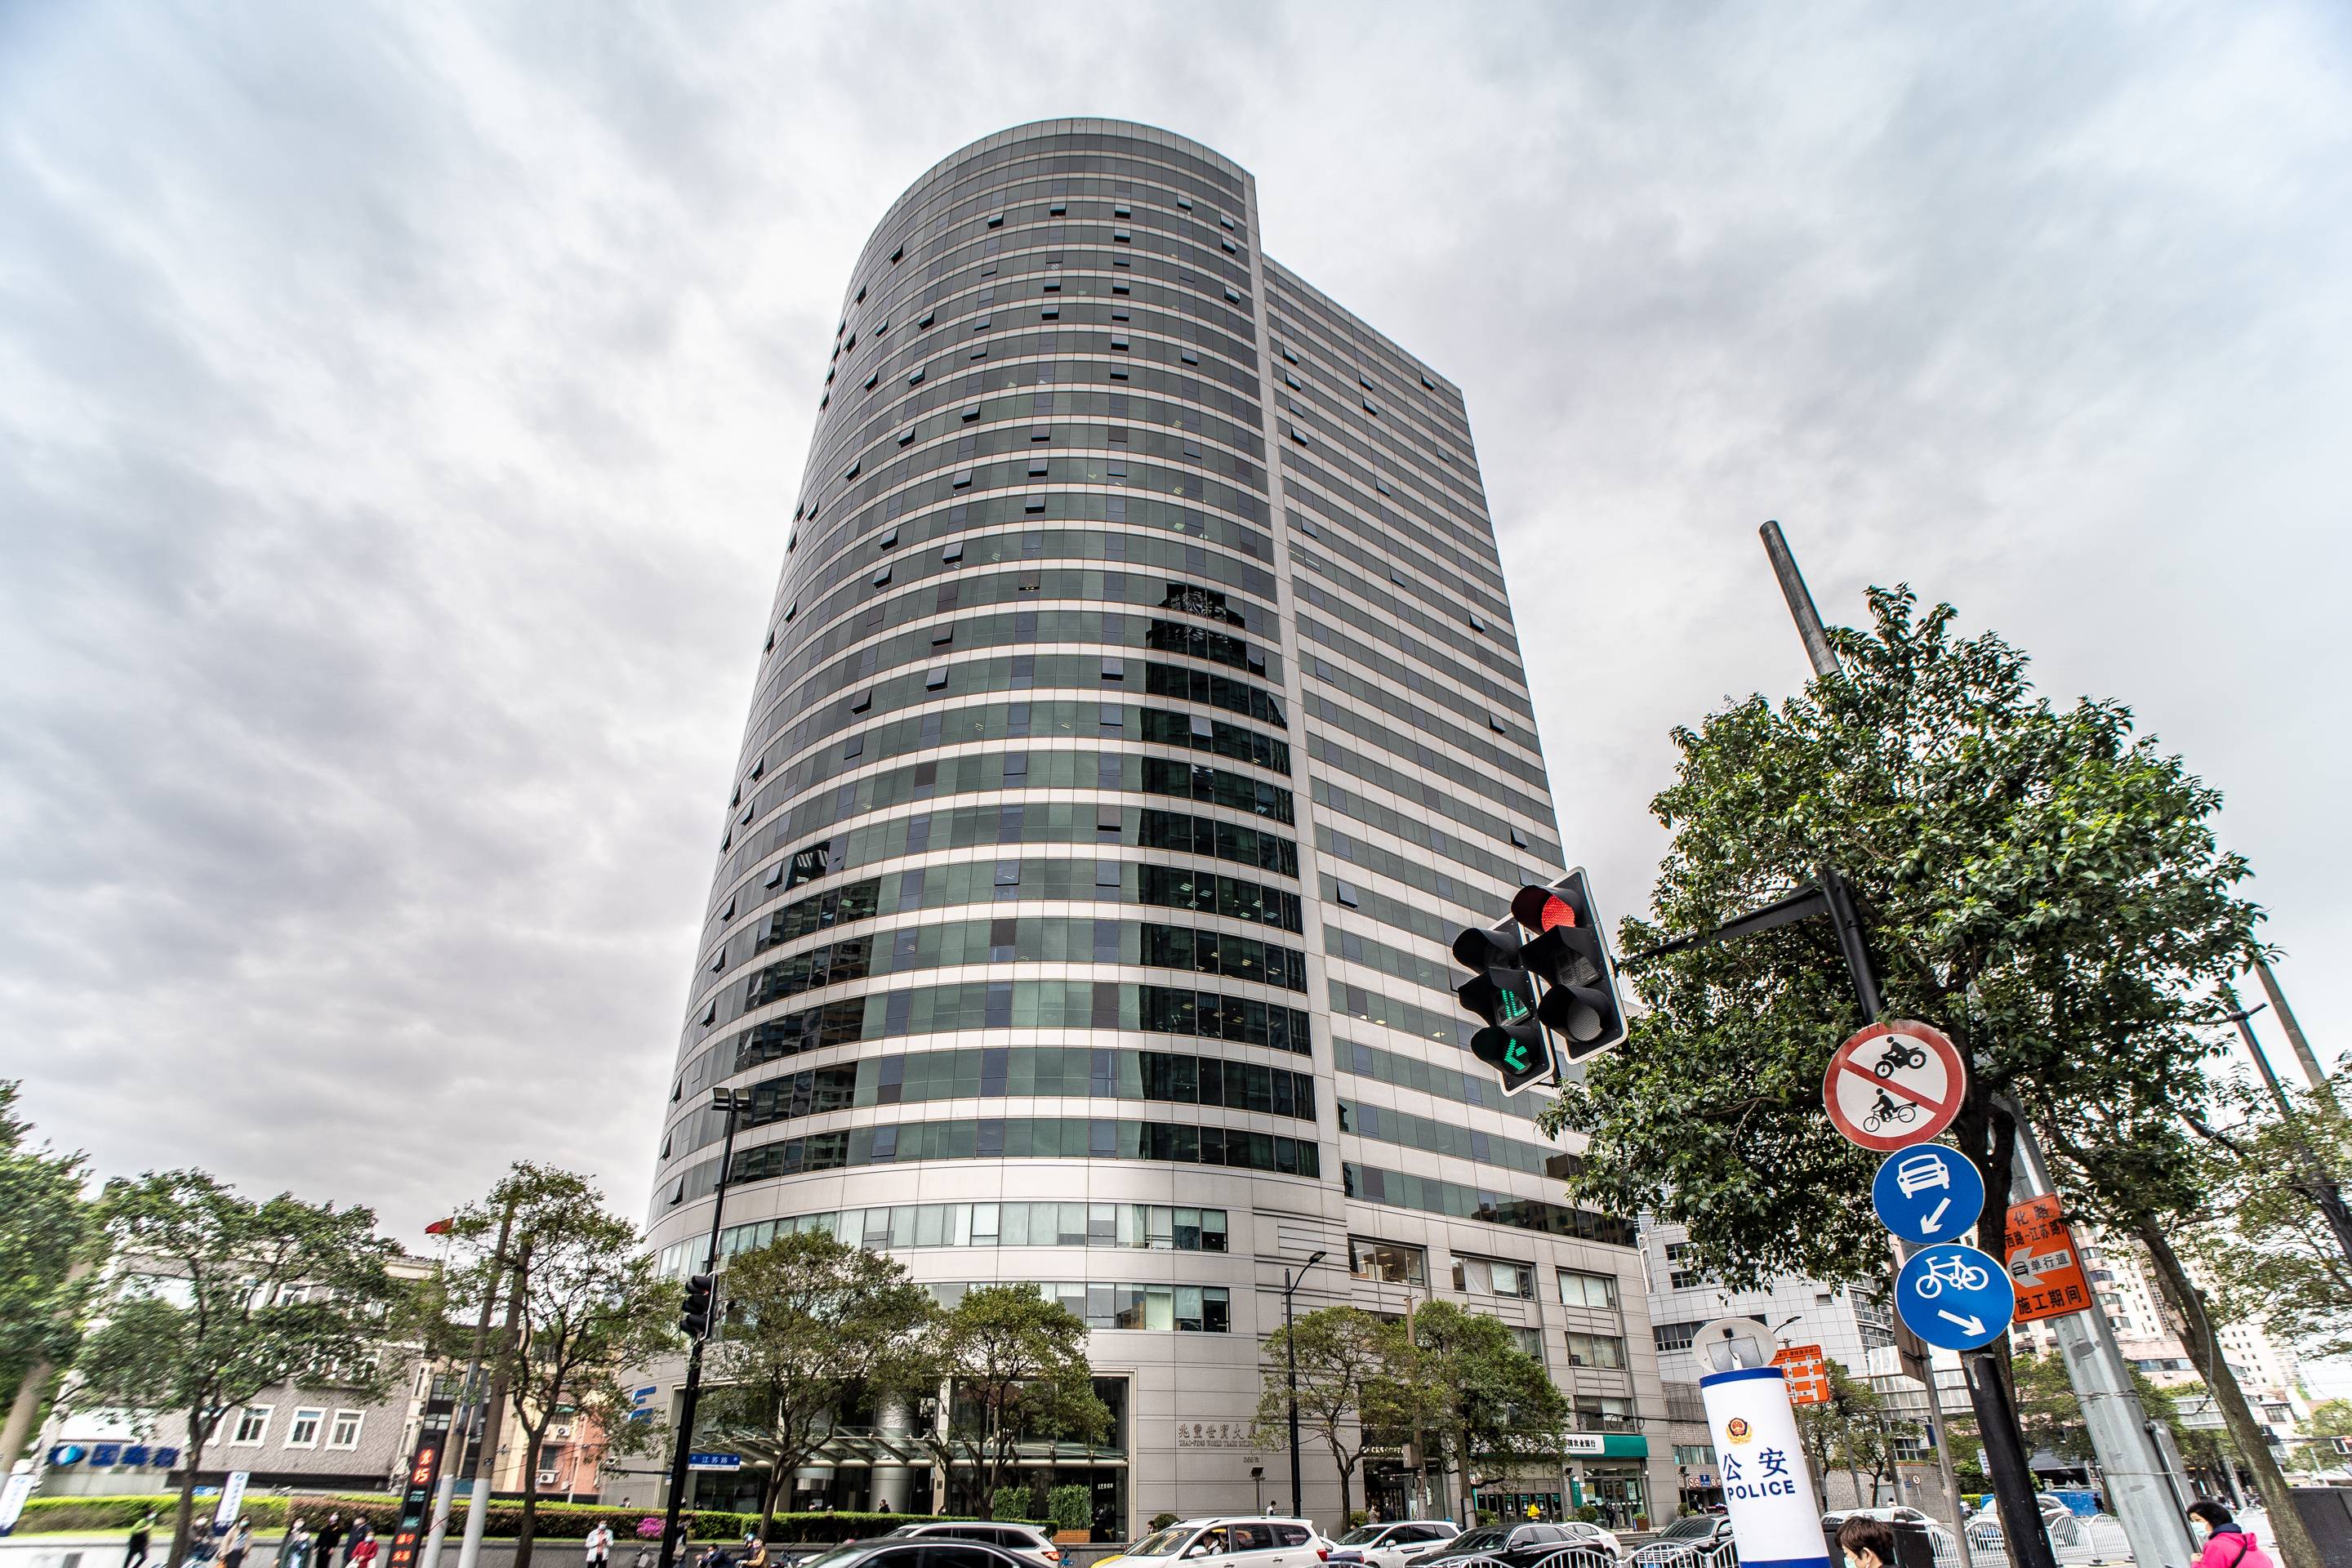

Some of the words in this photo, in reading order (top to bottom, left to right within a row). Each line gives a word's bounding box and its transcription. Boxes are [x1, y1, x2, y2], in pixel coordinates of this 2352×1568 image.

[2031, 1252, 2069, 1272] 单行道
[2016, 1285, 2082, 1316] 施工期间
[1723, 1447, 1788, 1481] 公安
[1727, 1480, 1795, 1501] POLICE
